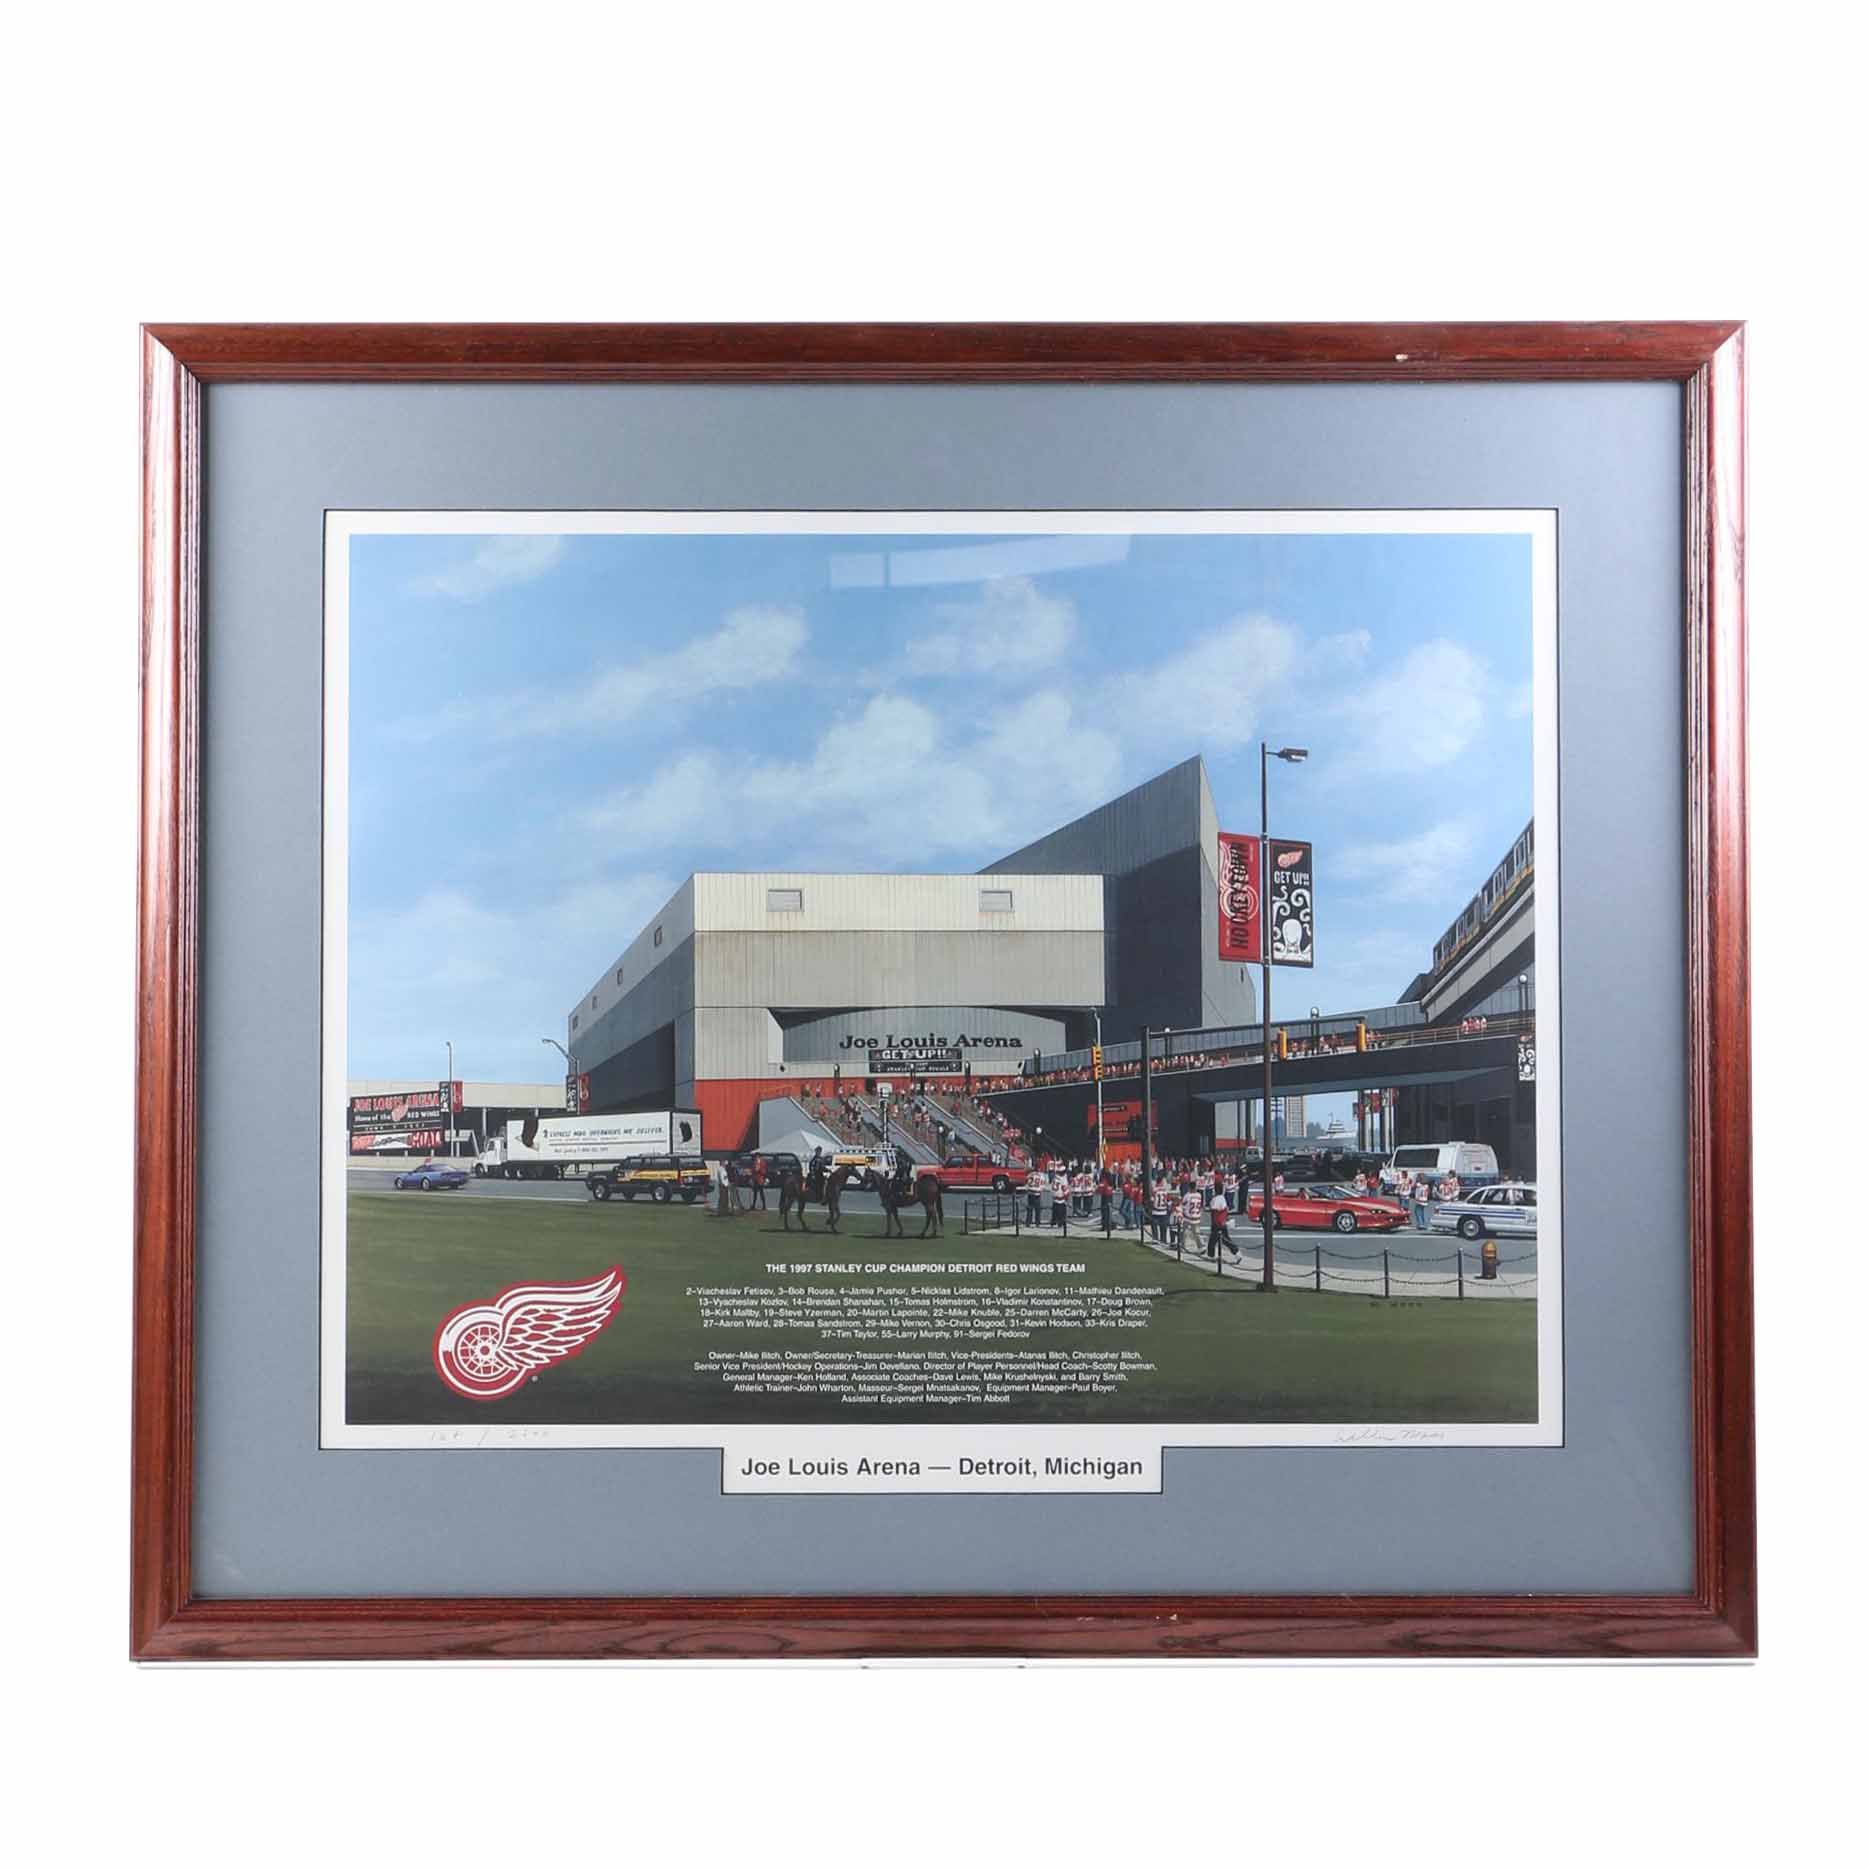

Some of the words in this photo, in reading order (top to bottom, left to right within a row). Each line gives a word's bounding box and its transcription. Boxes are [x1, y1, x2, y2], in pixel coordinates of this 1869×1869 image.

[1273, 871, 1290, 884] GET
[839, 1034, 879, 1049] Joe
[886, 1033, 948, 1048] Louis
[952, 1033, 1022, 1048] Arena
[881, 1049, 908, 1060] GET
[765, 1263, 787, 1273] THE
[790, 1263, 813, 1273] 1997
[815, 1263, 863, 1273] STANLEY
[865, 1263, 887, 1273] CUP
[889, 1263, 945, 1273] CHAMPION
[949, 1263, 993, 1273] DETROIT
[996, 1263, 1018, 1273] RED
[1020, 1263, 1054, 1273] WINGS
[1057, 1263, 1085, 1273] TEAM
[741, 1458, 780, 1476] Joe
[788, 1457, 849, 1476] Louis
[856, 1458, 921, 1476] Arena
[959, 1457, 1037, 1479] Detroit,
[1044, 1457, 1143, 1479] Michigan
